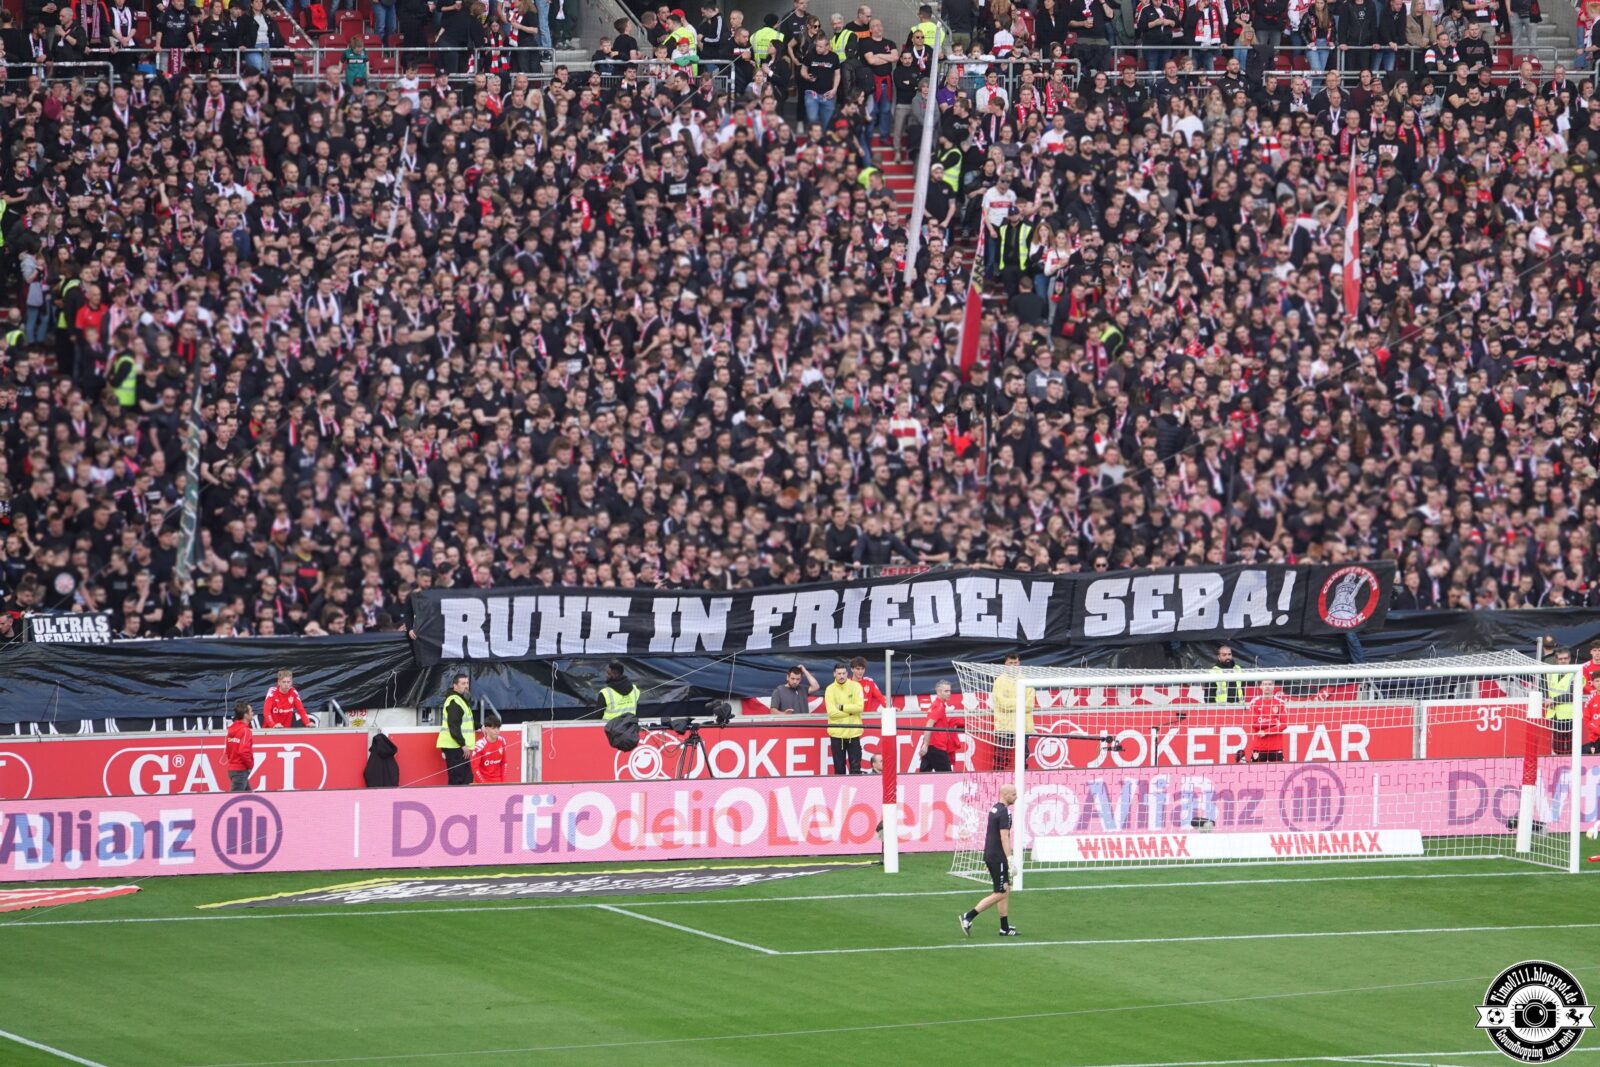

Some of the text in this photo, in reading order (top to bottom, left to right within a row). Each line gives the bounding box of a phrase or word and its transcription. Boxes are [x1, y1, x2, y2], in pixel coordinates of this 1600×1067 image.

[32, 615, 109, 634] ULTRAS
[440, 570, 1298, 660] RUHE IN FRIEDEN SEBA!
[1476, 706, 1502, 732] 35
[0, 809, 196, 864] Allianz
[391, 801, 478, 857] Da
[522, 786, 858, 850] FOLLOW
[1077, 835, 1190, 859] WINAMAX
[1270, 831, 1383, 855] WINAMAX
